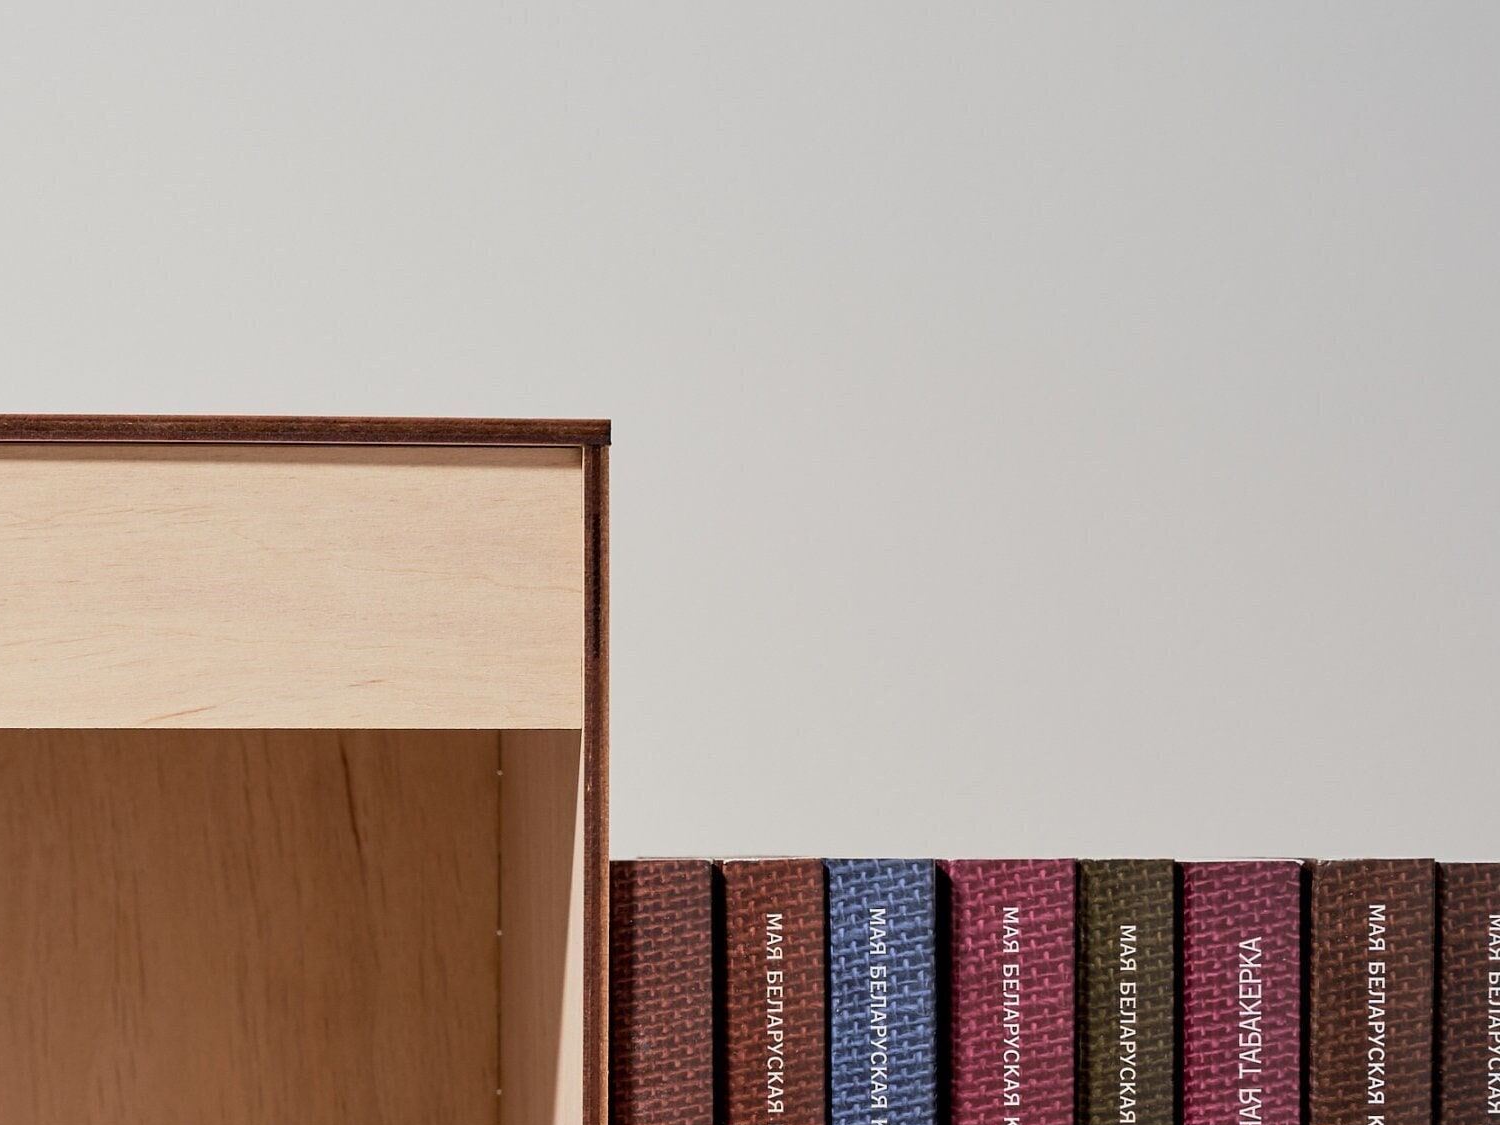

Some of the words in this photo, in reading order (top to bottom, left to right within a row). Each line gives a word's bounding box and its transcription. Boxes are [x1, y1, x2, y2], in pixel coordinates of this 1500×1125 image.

[766, 913, 784, 960] МАЯ
[869, 908, 888, 955] МАЯ
[1002, 906, 1021, 953] МАЯ
[1118, 925, 1137, 971] МАЯ
[1367, 904, 1386, 951] МАЯ
[766, 970, 784, 1113] БЕЛАРУСКАЯ
[869, 965, 888, 1109] БЕЛАРУСКАЯ
[1002, 963, 1021, 1106] БЕЛАРУСКАЯ
[1118, 982, 1137, 1124] БЕЛАРУСКАЯ
[1238, 936, 1262, 1080] ТАБАКЕРКА
[1367, 961, 1386, 1104] БЕЛАРУСКАЯ
